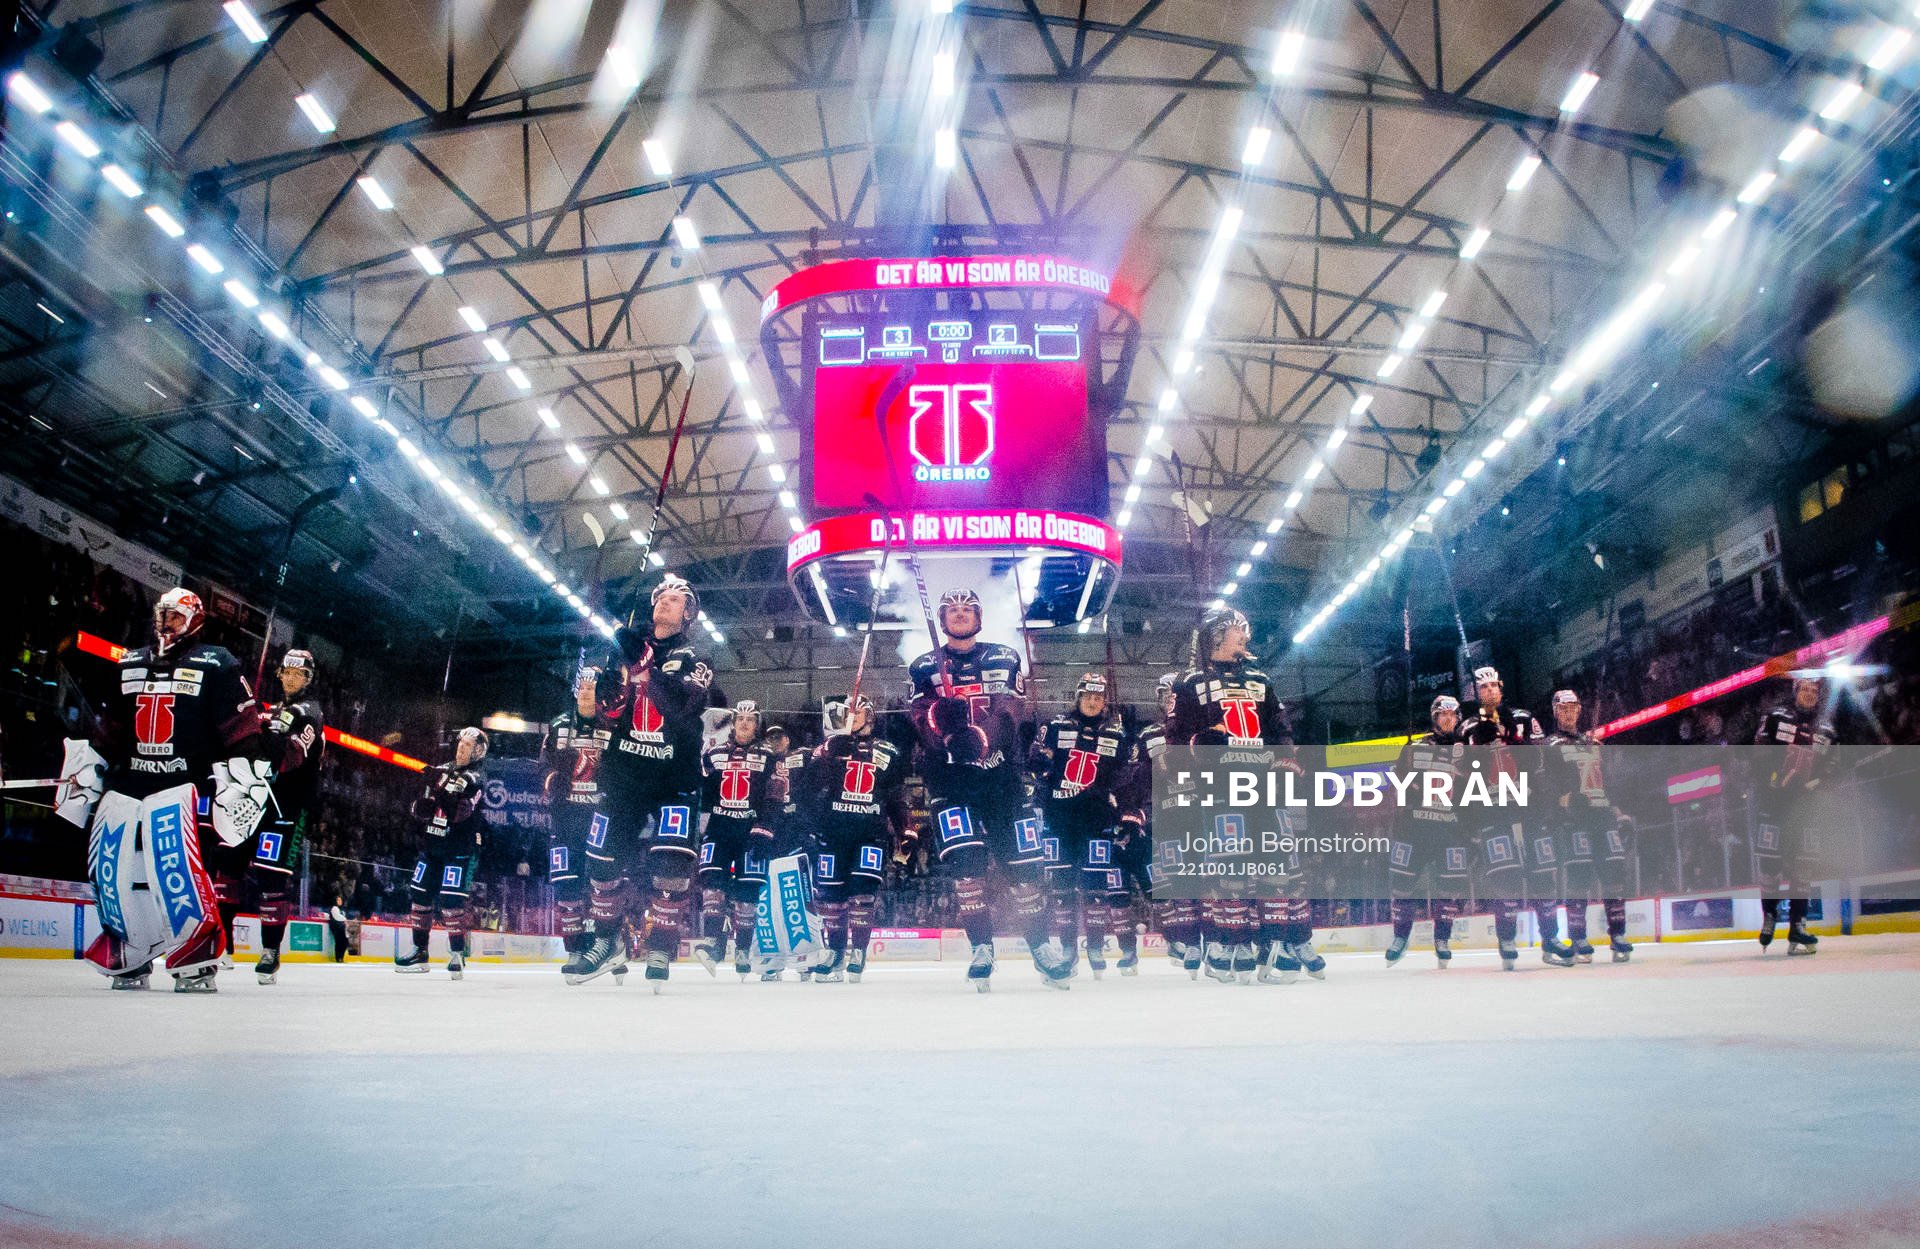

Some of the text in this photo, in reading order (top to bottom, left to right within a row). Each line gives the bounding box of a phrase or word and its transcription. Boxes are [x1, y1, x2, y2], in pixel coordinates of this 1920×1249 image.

[876, 260, 1110, 294] DET ÄR VI SOM ÄR ÖREBRO
[894, 331, 904, 343] 3
[938, 325, 965, 337] 0:00
[996, 329, 1005, 341] 2
[915, 465, 990, 481] ÖREBRO
[913, 514, 939, 540] ÄR
[943, 516, 963, 539] VI
[966, 516, 1011, 539] SOM
[1015, 512, 1042, 539] ÄR
[1045, 513, 1106, 550] ÖREBRO
[619, 738, 663, 759] BEHRN
[832, 802, 869, 814] BEHRN
[157, 812, 193, 915] HEROK
[101, 841, 124, 934] HEROK
[783, 875, 805, 938] HEROK
[9, 920, 58, 937] WELINS
